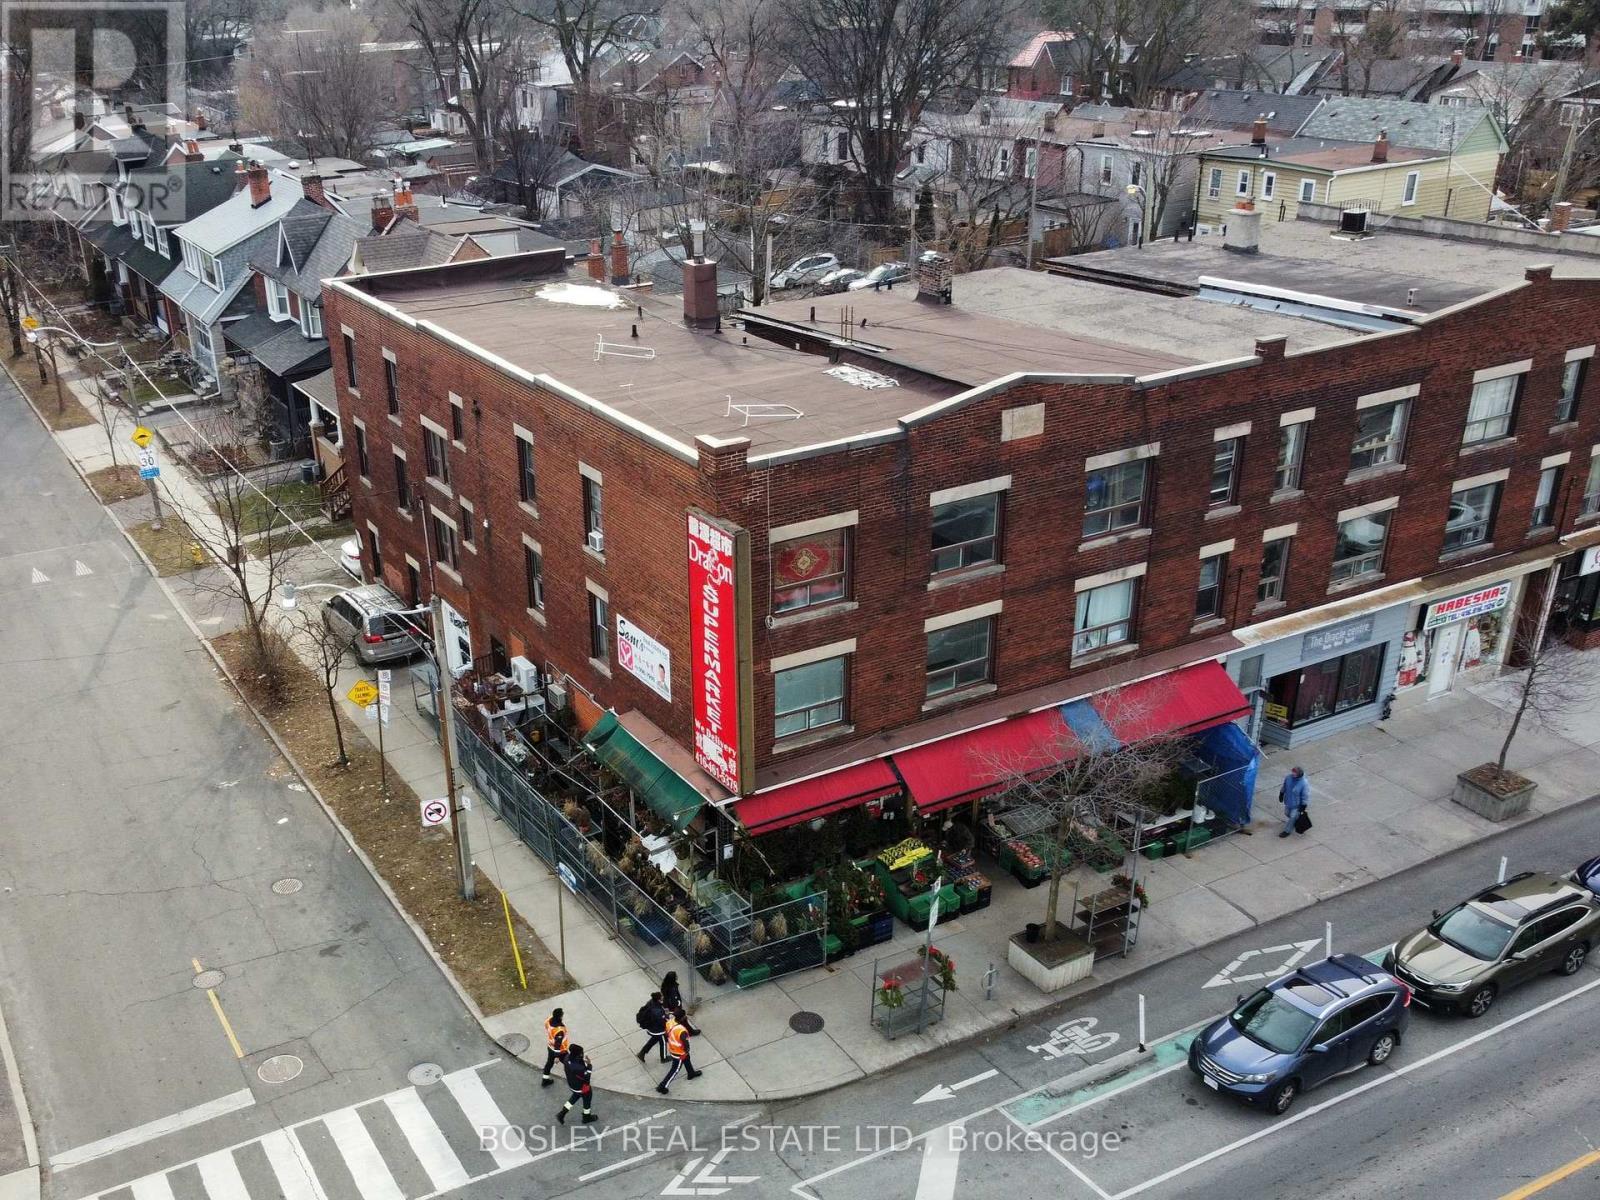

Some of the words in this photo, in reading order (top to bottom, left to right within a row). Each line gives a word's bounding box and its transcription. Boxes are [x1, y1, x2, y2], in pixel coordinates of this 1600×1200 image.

[141, 456, 155, 467] 30
[688, 538, 734, 588] Dragon
[1436, 587, 1500, 614] HABESHA
[702, 584, 722, 734] SUPERMARKET
[705, 727, 737, 759] Delivery
